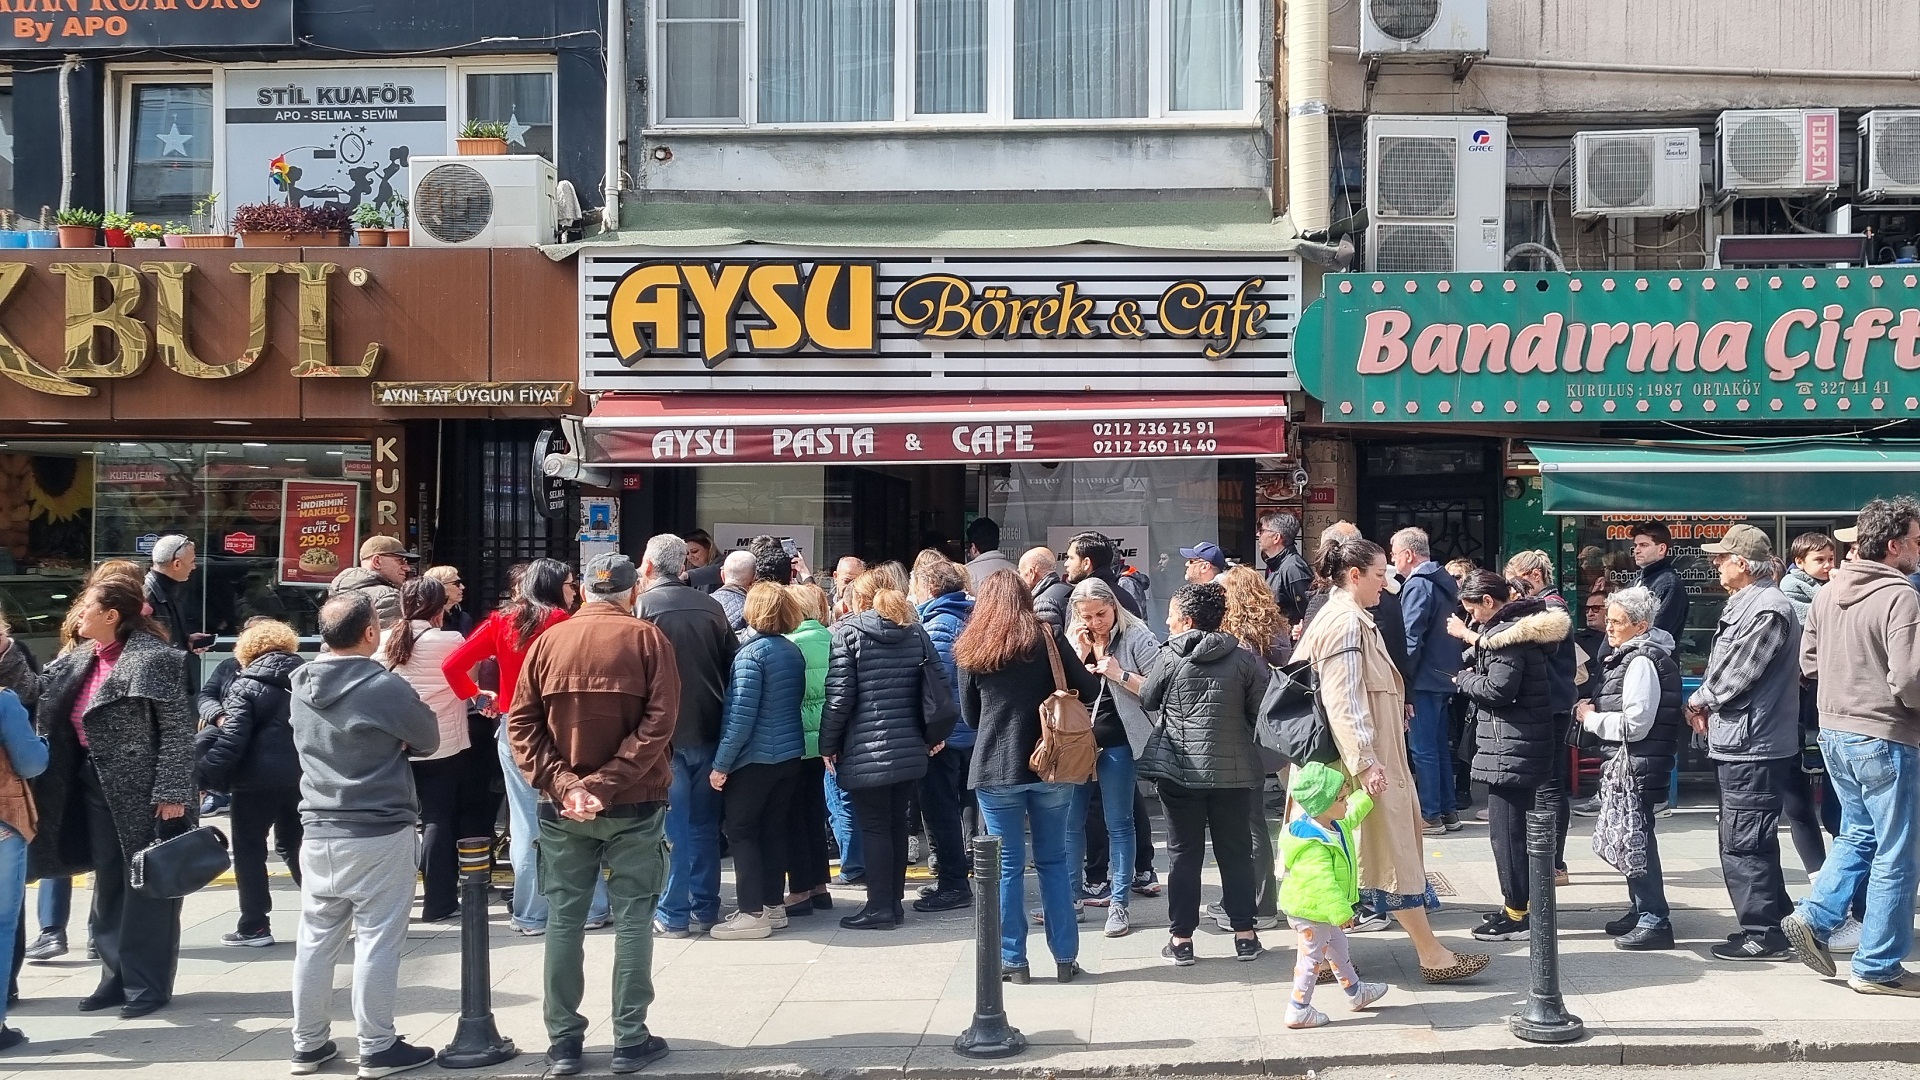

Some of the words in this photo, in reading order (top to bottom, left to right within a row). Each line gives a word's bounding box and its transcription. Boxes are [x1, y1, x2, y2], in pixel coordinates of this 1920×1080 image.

[14, 17, 53, 42] By
[61, 16, 128, 37] APO
[257, 83, 311, 106] STİL
[316, 83, 415, 105] KUAFÖR
[275, 111, 300, 121] APO
[311, 110, 352, 121] SELMA
[362, 108, 398, 120] SEVİM
[1811, 116, 1828, 180] VESTEL
[607, 259, 880, 368] AYSU
[891, 273, 1100, 341] Börek
[1108, 299, 1149, 341] &
[1157, 276, 1271, 361] Cafe
[1356, 309, 1753, 376] Bandırma
[381, 389, 418, 402] AYNI
[424, 389, 450, 402] TAT
[456, 388, 514, 402] UYGUN
[520, 386, 561, 402] FİYAT
[1648, 382, 1683, 397] 1987
[1693, 379, 1761, 397] ORTAKÖY
[1820, 381, 1846, 395] 327
[1852, 381, 1867, 394] 41
[1873, 380, 1890, 394] 41
[1092, 422, 1132, 436] 0212
[1138, 422, 1167, 436] 236
[1172, 421, 1191, 435] 25
[1195, 421, 1215, 434] 91
[651, 428, 735, 459] AYSU
[772, 427, 874, 458] PASTA
[905, 433, 923, 452] &
[952, 424, 1035, 456] CAFE
[1093, 440, 1132, 453] 0212
[1138, 439, 1167, 453] 260
[1173, 439, 1192, 452] 14
[1196, 438, 1217, 452] 40
[376, 437, 400, 539] KUR
[1314, 492, 1328, 500] 101
[302, 525, 326, 533] CEVİZ
